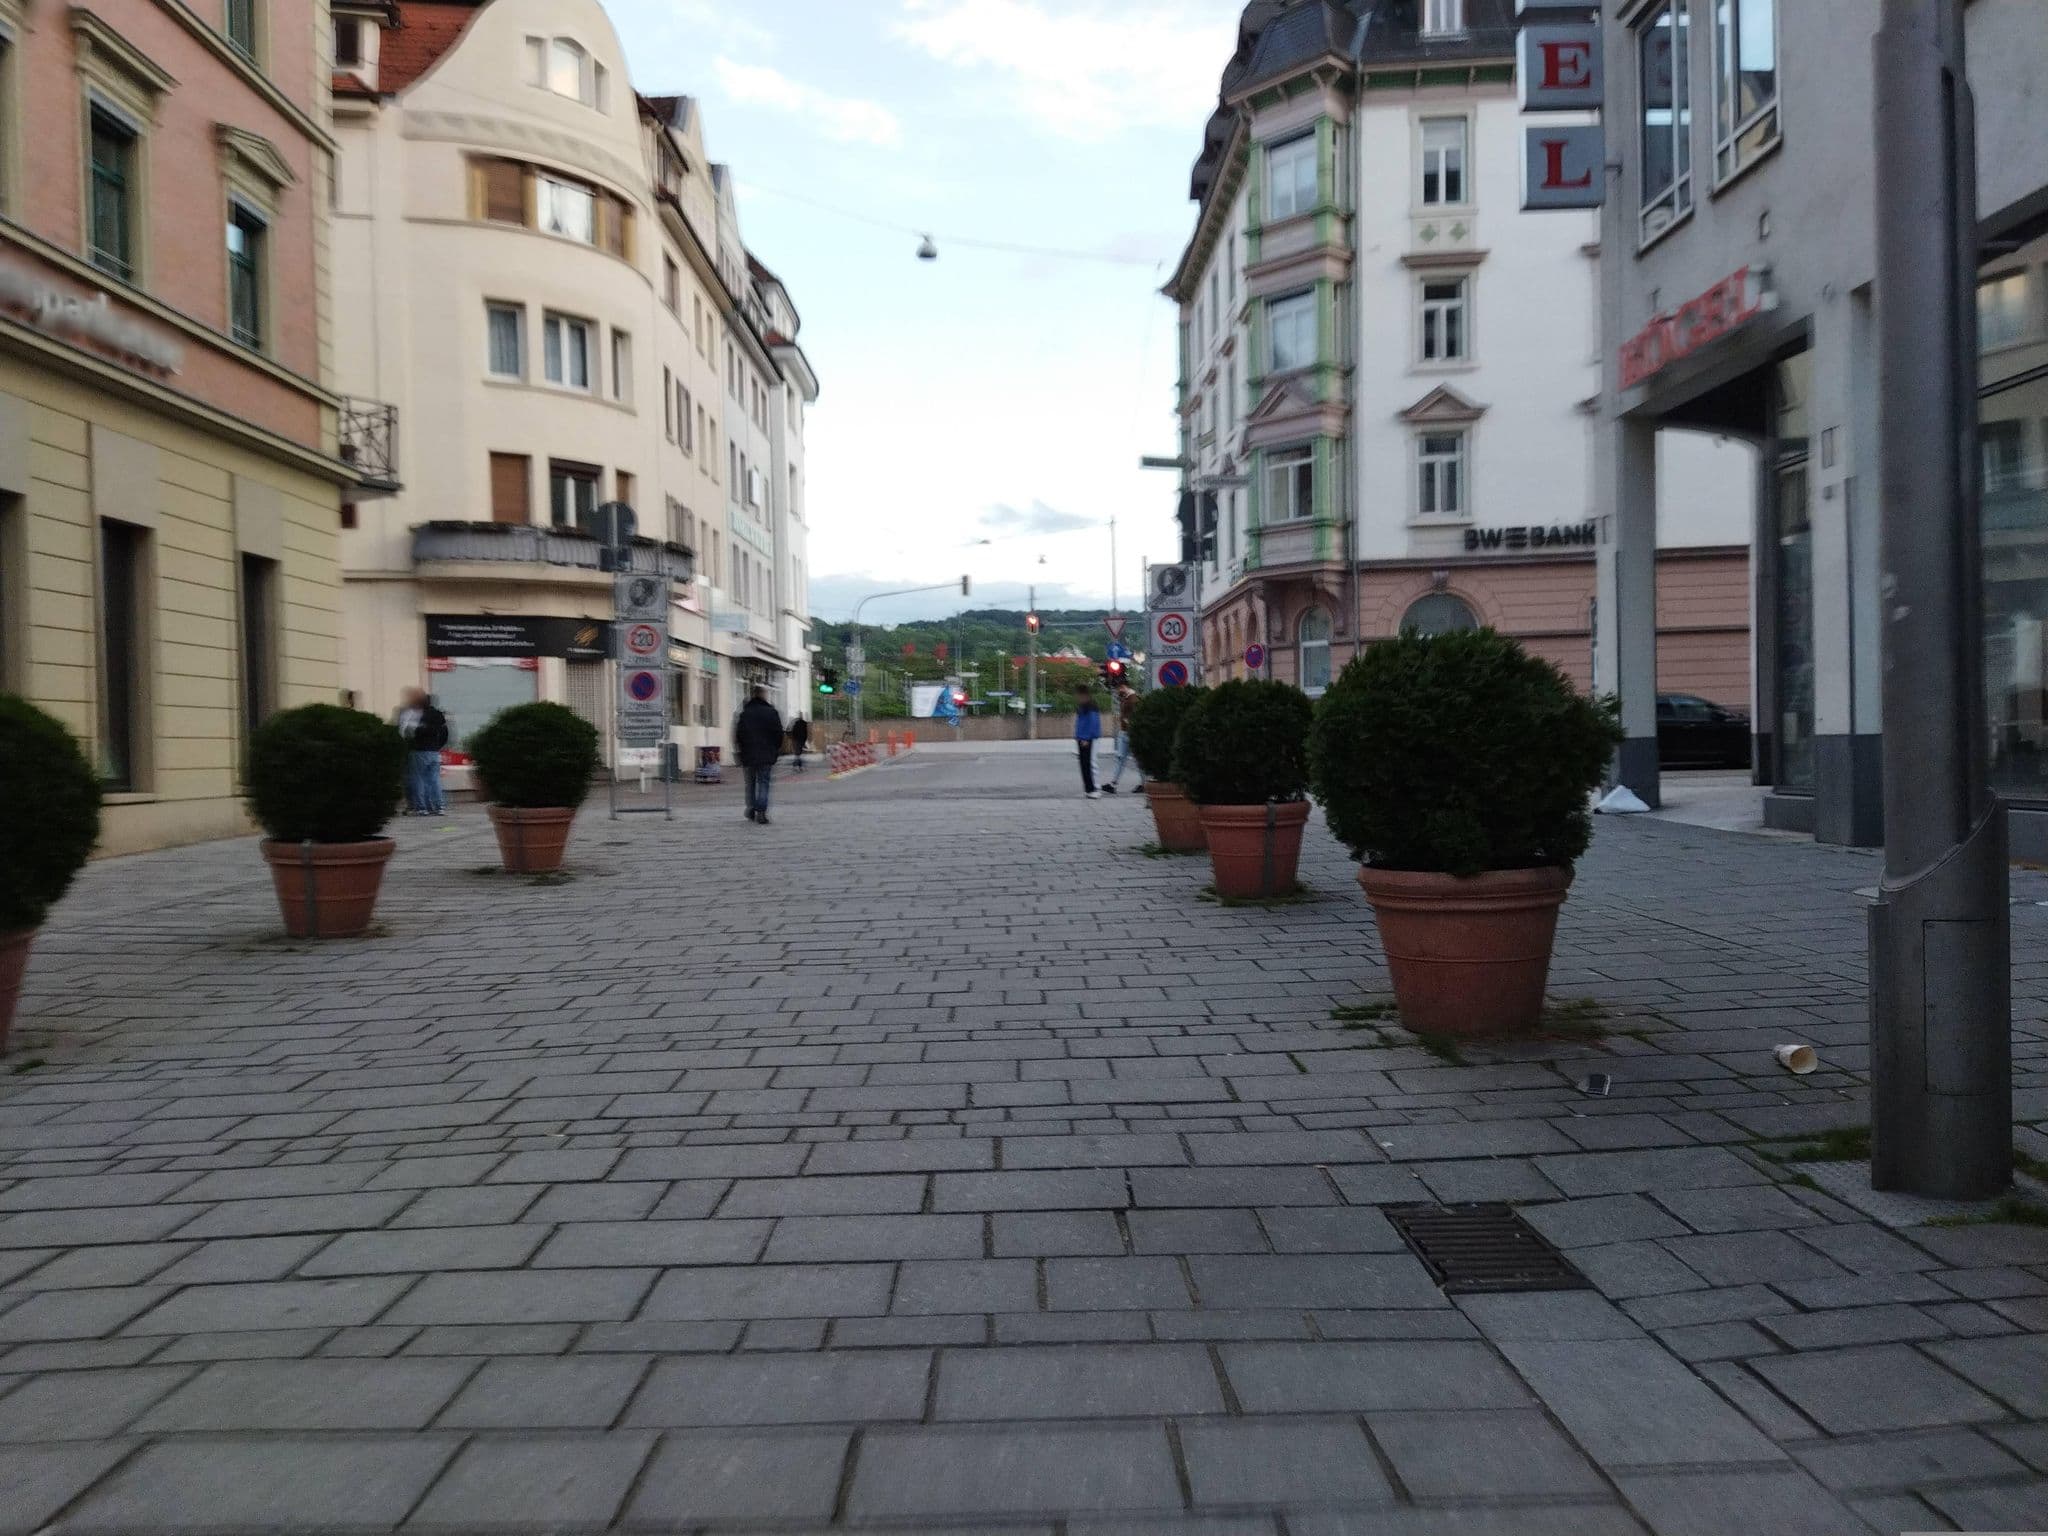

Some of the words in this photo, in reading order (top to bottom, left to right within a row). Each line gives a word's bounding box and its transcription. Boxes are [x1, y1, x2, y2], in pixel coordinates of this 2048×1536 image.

[1464, 527, 1502, 551] BW
[1531, 523, 1597, 546] BANK
[1164, 621, 1181, 636] 20
[1162, 645, 1183, 653] ZONE
